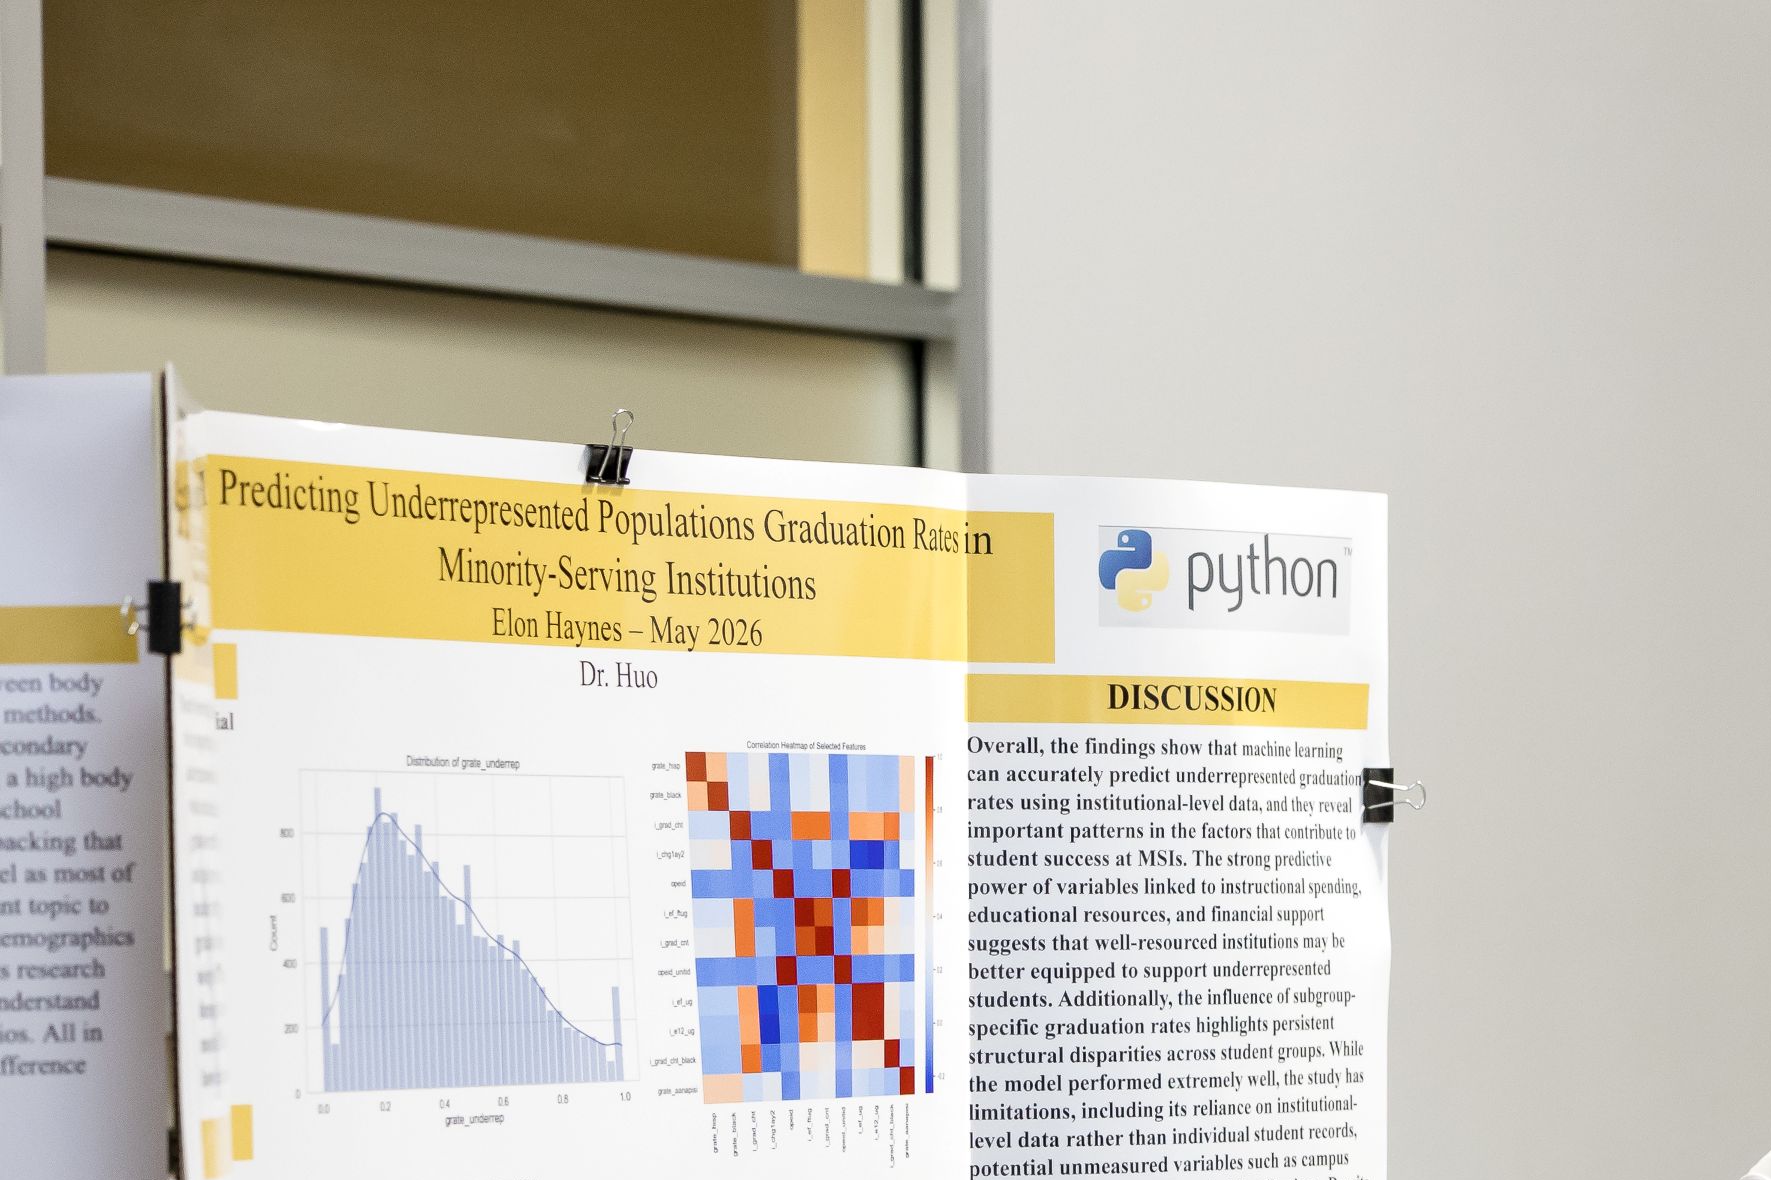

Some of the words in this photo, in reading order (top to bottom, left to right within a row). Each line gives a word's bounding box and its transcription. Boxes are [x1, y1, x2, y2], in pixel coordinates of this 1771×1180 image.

[219, 469, 360, 524] Predicting
[367, 481, 589, 534] Underrepresented
[598, 500, 754, 545] Populations
[764, 510, 905, 548] Graduation
[913, 518, 958, 553] Rates
[965, 522, 993, 554] in
[438, 547, 657, 603] Minority-Serving
[666, 562, 816, 600] Institutions
[1188, 533, 1337, 612] python
[492, 608, 538, 637] Elon
[546, 611, 622, 647] Haynes
[650, 616, 700, 652] May
[708, 618, 762, 646] 2026
[49, 672, 103, 697] body
[580, 661, 608, 687] Dr.
[616, 662, 657, 688] Huo
[1107, 684, 1276, 712] DISCUSSION
[4, 704, 102, 723] methods.
[747, 741, 779, 749] Correlation
[781, 742, 808, 751] Heatmap
[809, 742, 816, 750] of
[817, 742, 841, 750] Selected
[842, 742, 866, 751] Features
[968, 736, 1044, 757] Overall,
[1051, 737, 1078, 754] the
[1085, 738, 1155, 759] findings
[1162, 739, 1202, 755] show
[1208, 739, 1237, 755] that
[1243, 741, 1290, 757] machine
[1295, 742, 1342, 762] learning
[7, 773, 18, 787] a
[26, 767, 73, 793] high
[80, 766, 134, 793] body
[968, 770, 999, 781] can
[1007, 766, 1103, 787] accurately
[1110, 766, 1170, 787] predict
[1177, 767, 1295, 788] underrepresented
[1300, 770, 1362, 788] graduation
[84, 833, 123, 852] that
[968, 821, 1064, 843] important
[1070, 824, 1143, 843] patterns
[1150, 822, 1164, 838] in
[1171, 822, 1196, 838] the
[1202, 823, 1251, 838] factors
[1257, 823, 1280, 839] that
[1285, 824, 1342, 840] contribute
[1346, 827, 1355, 839] to
[24, 869, 47, 884] as
[54, 866, 106, 884] most
[112, 862, 135, 884] of
[969, 883, 1027, 899] power
[1033, 878, 1053, 895] of
[1057, 878, 1138, 894] variables
[1144, 878, 1195, 894] linked
[1202, 880, 1215, 894] to
[1221, 878, 1304, 894] instructional
[1309, 878, 1361, 898] spending,
[29, 897, 80, 922] topic
[89, 898, 109, 915] to
[17, 960, 105, 980] research
[42, 1024, 78, 1043] All
[83, 1025, 103, 1043] in
